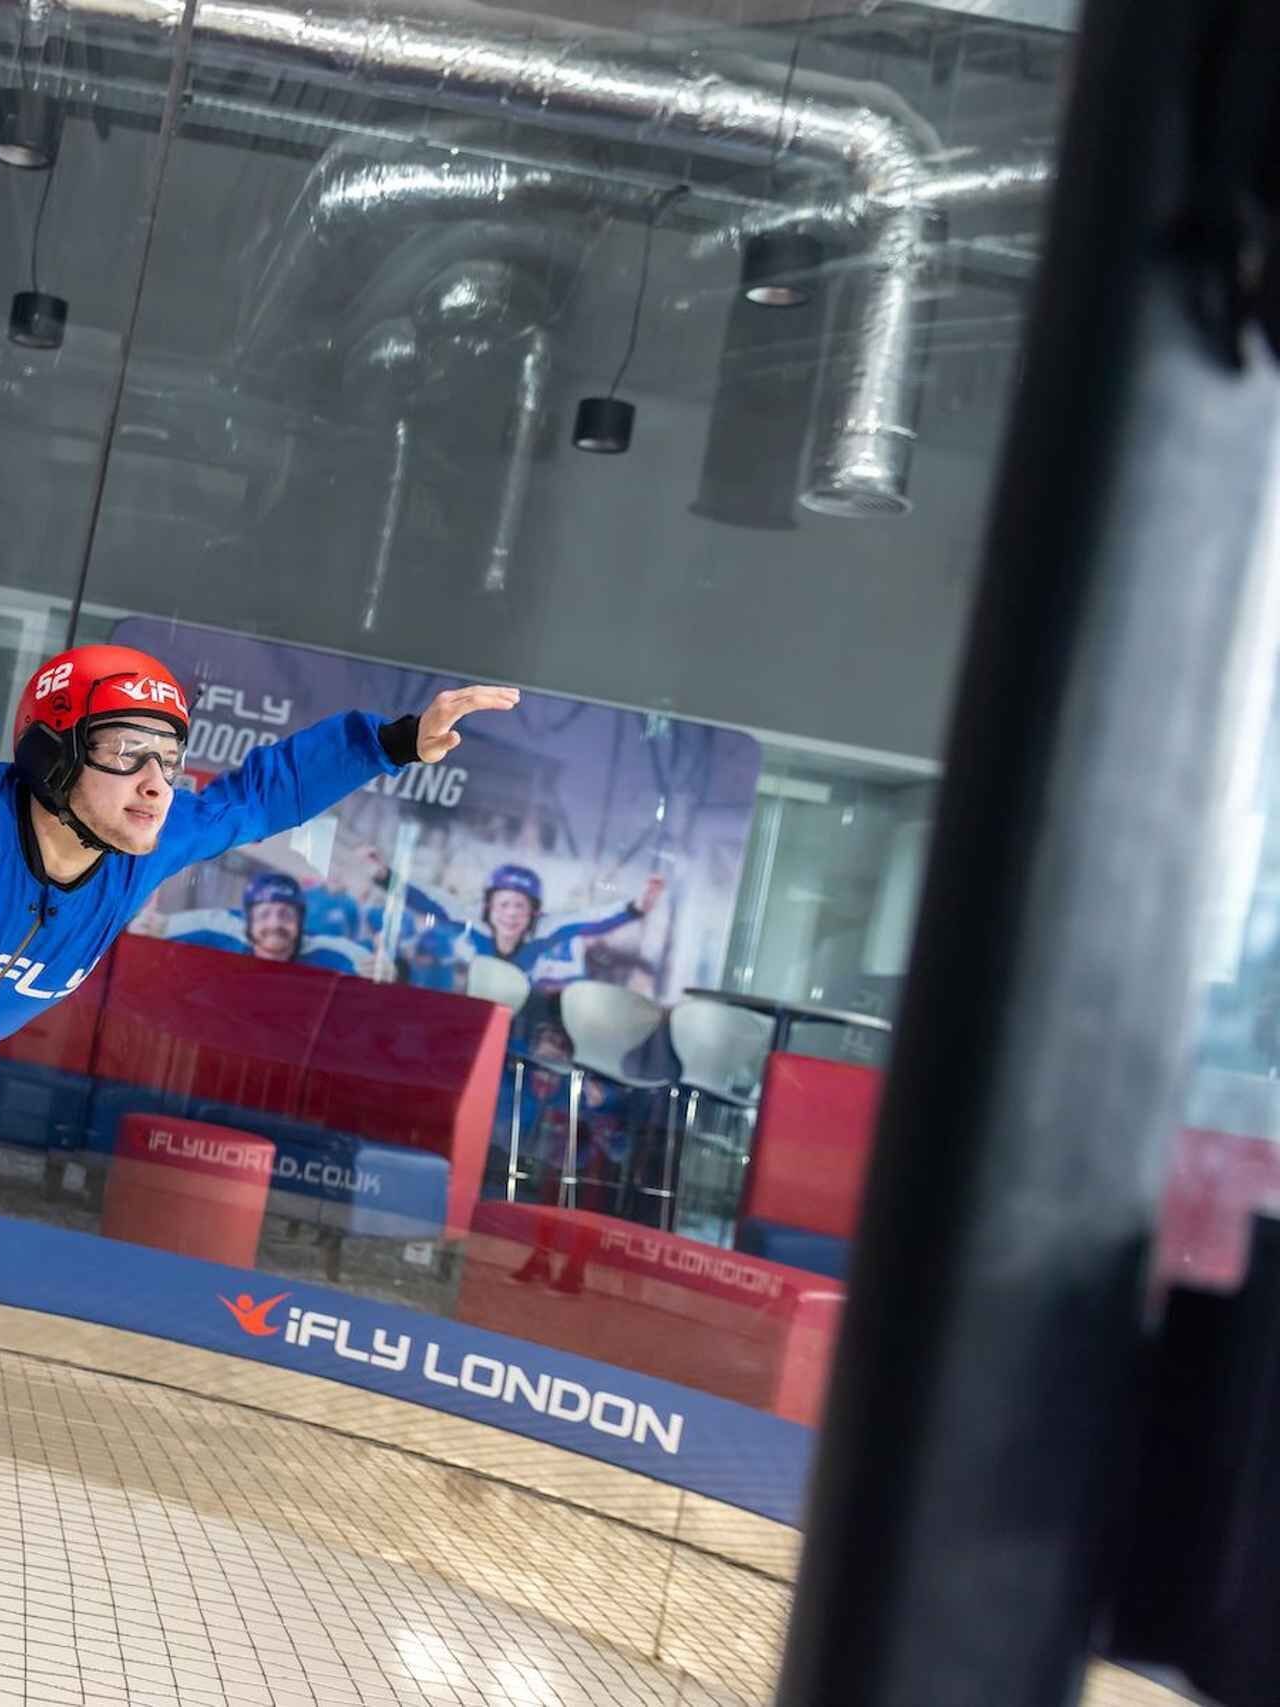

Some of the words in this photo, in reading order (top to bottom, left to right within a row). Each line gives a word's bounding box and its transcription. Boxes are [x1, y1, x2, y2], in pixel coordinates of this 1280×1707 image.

[35, 662, 74, 700] 52
[149, 678, 188, 719] iFL
[149, 1129, 382, 1195] iFLYWORLD.CO.UK
[662, 1245, 785, 1298] LONDON
[284, 1297, 412, 1372] iFLY
[423, 1342, 684, 1455] LONDON
